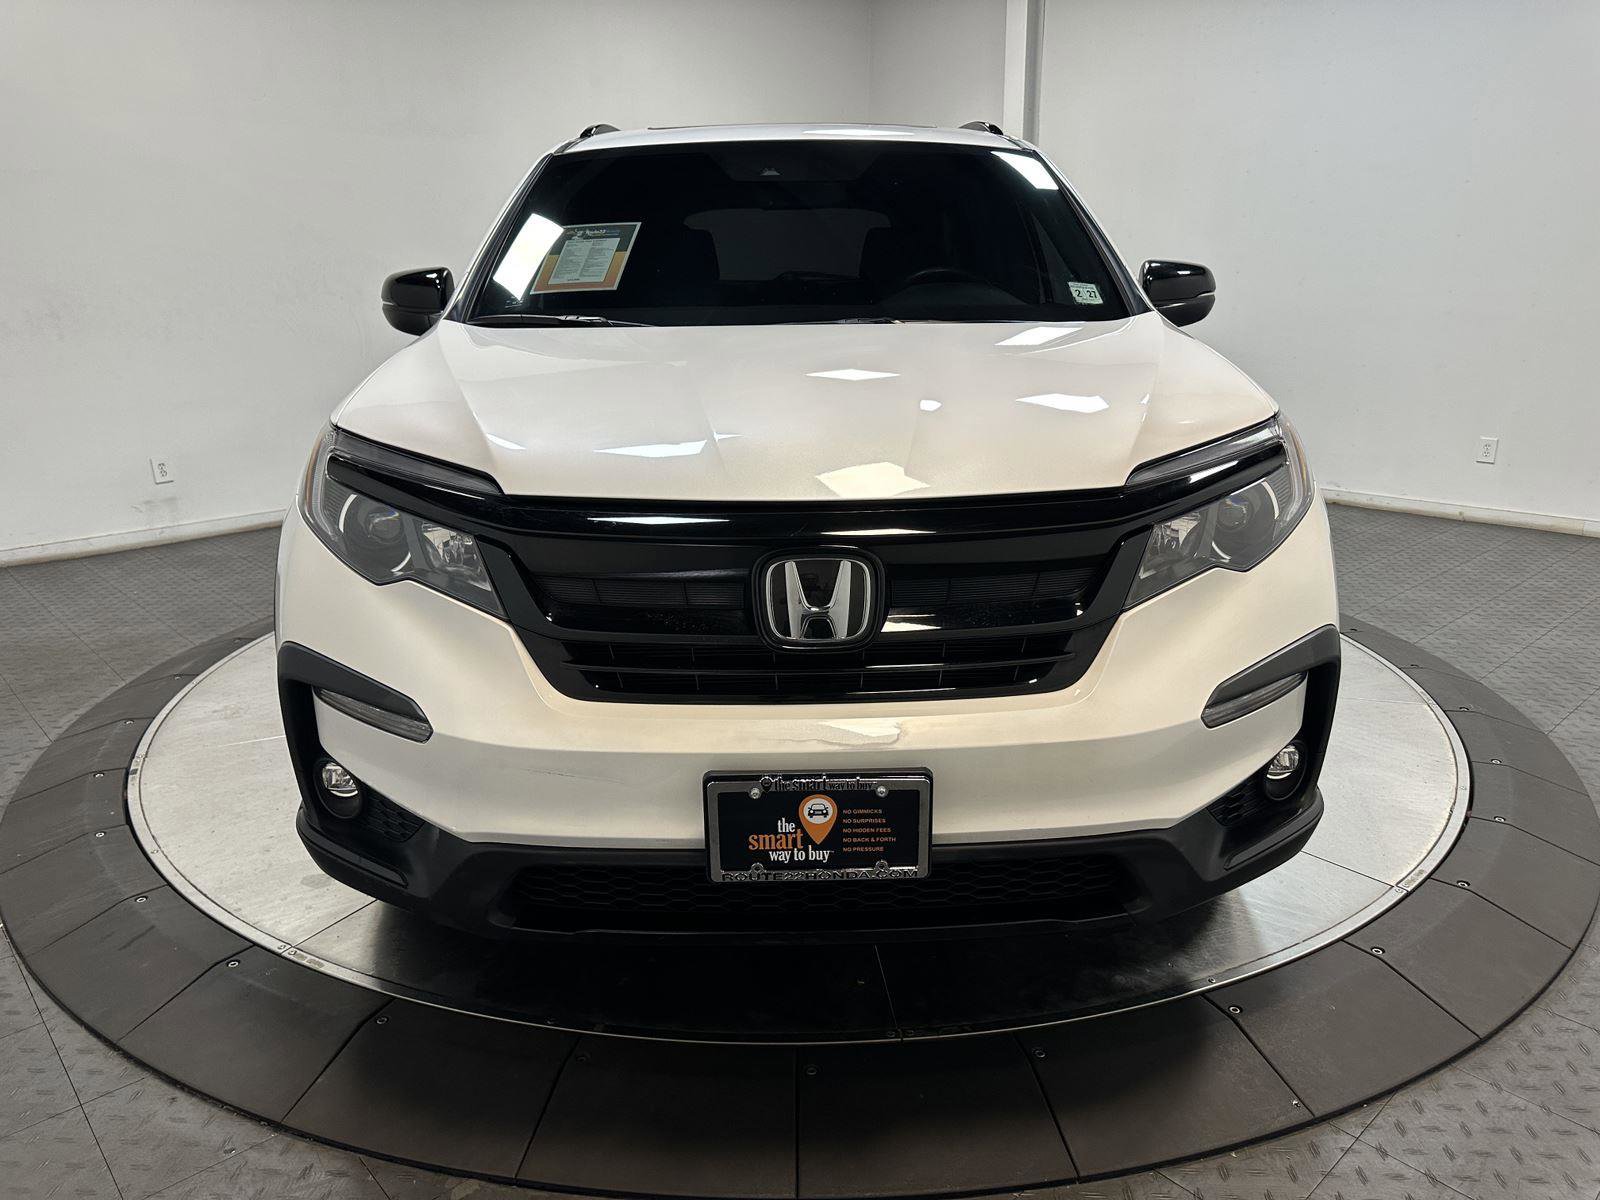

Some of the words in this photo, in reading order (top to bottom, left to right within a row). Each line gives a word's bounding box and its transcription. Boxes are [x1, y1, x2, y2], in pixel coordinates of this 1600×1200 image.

[1074, 289, 1083, 298] 2
[1086, 290, 1098, 299] 27
[777, 817, 796, 833] the
[748, 829, 804, 851] smart
[769, 850, 790, 864] way
[793, 848, 806, 862] to
[808, 845, 831, 863] buy
